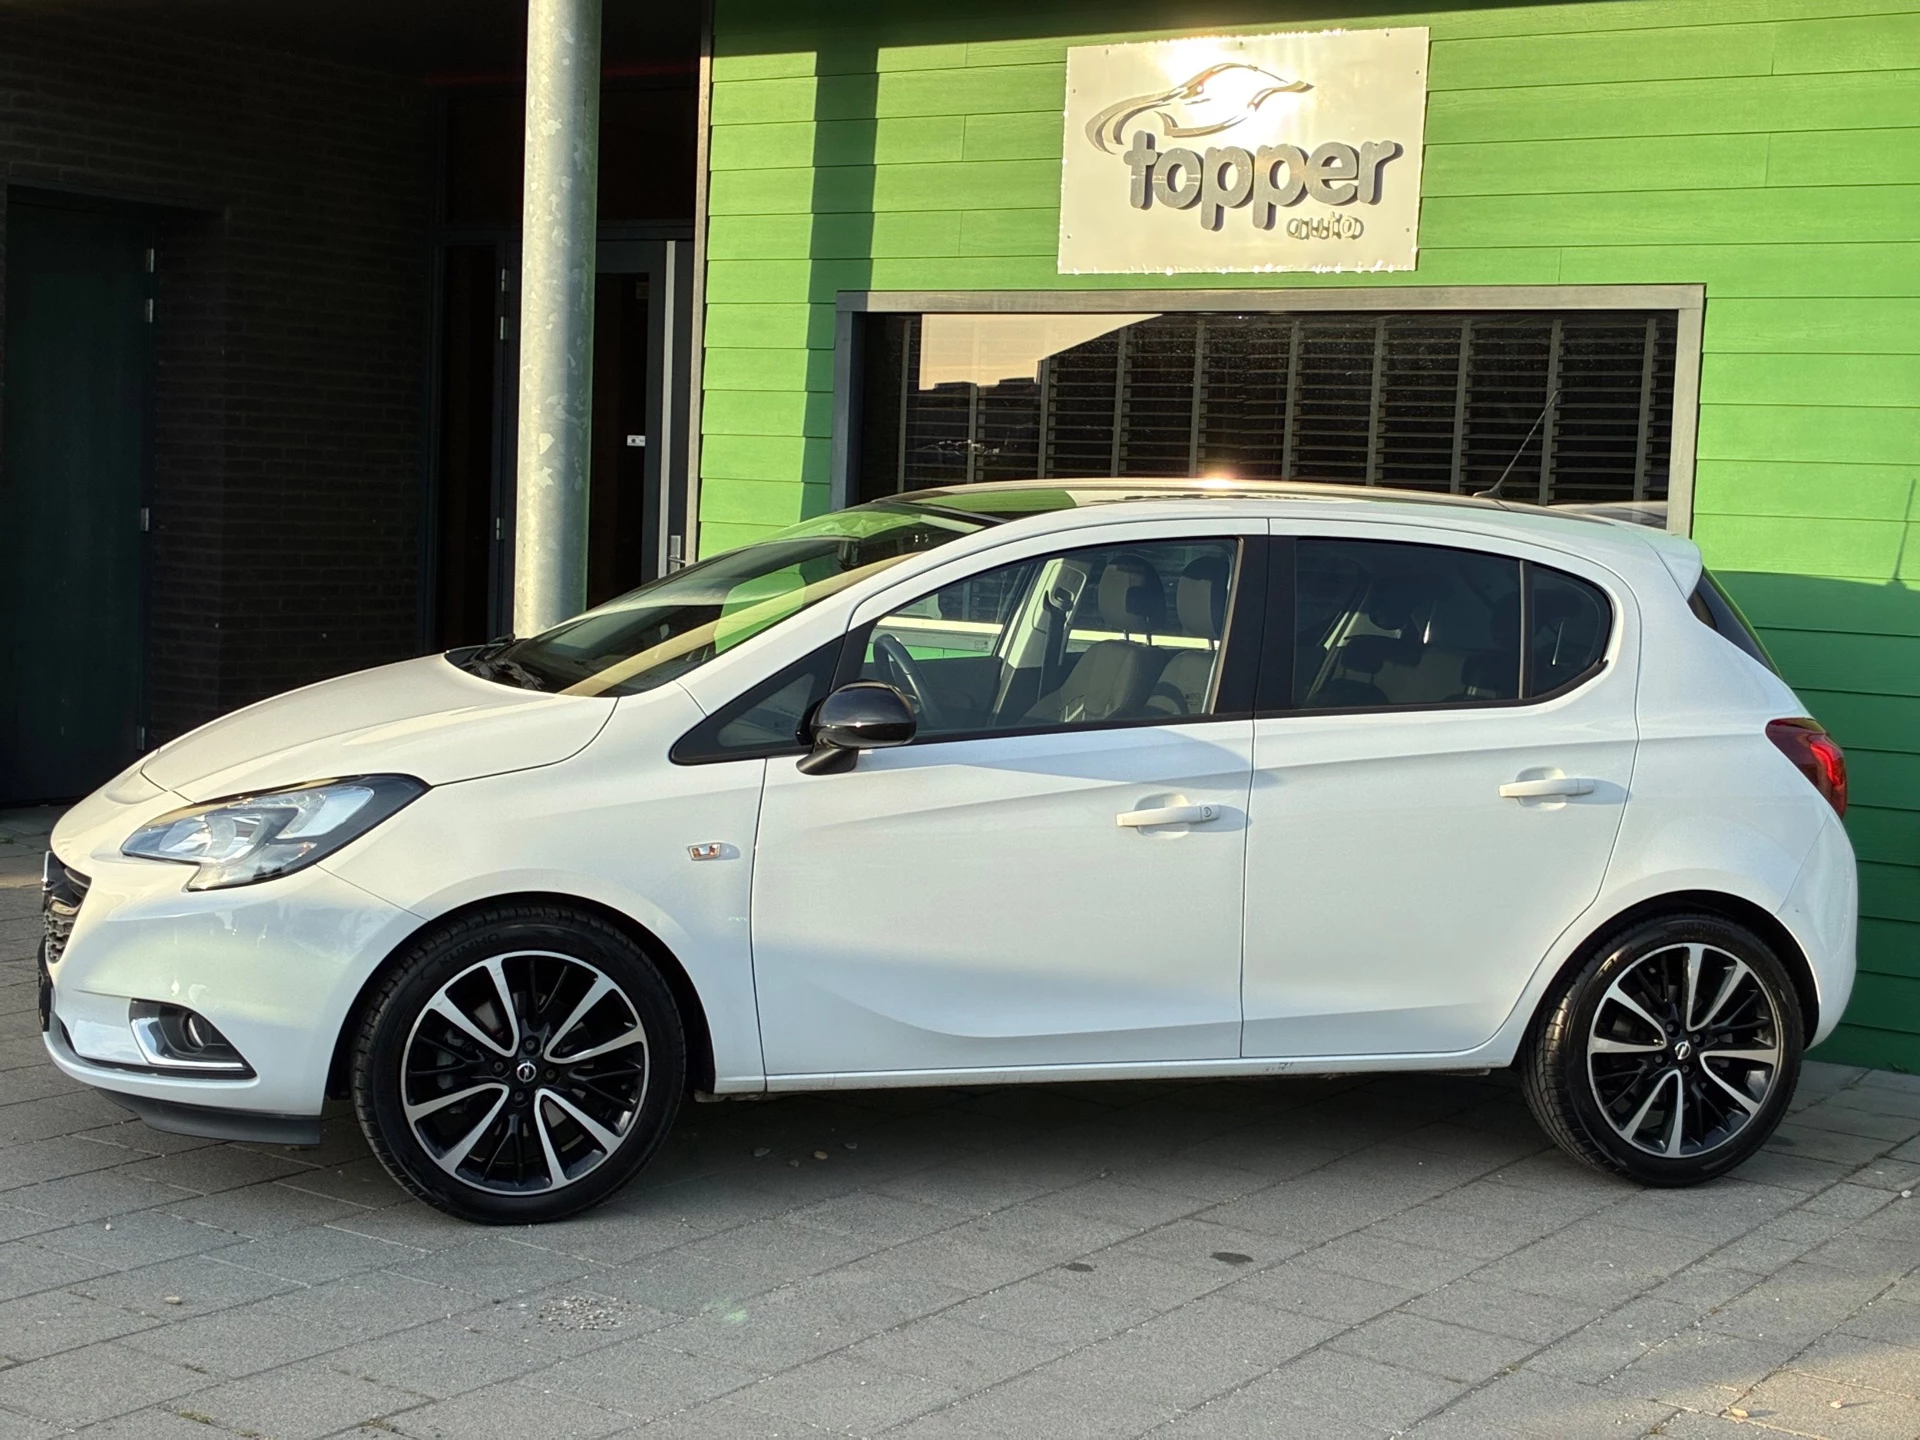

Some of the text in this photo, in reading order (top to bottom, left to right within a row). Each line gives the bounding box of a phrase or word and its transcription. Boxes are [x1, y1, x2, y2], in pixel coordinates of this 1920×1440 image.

[1123, 130, 1402, 231] topper
[1287, 211, 1364, 240] auto
[438, 932, 499, 965] KUMHO
